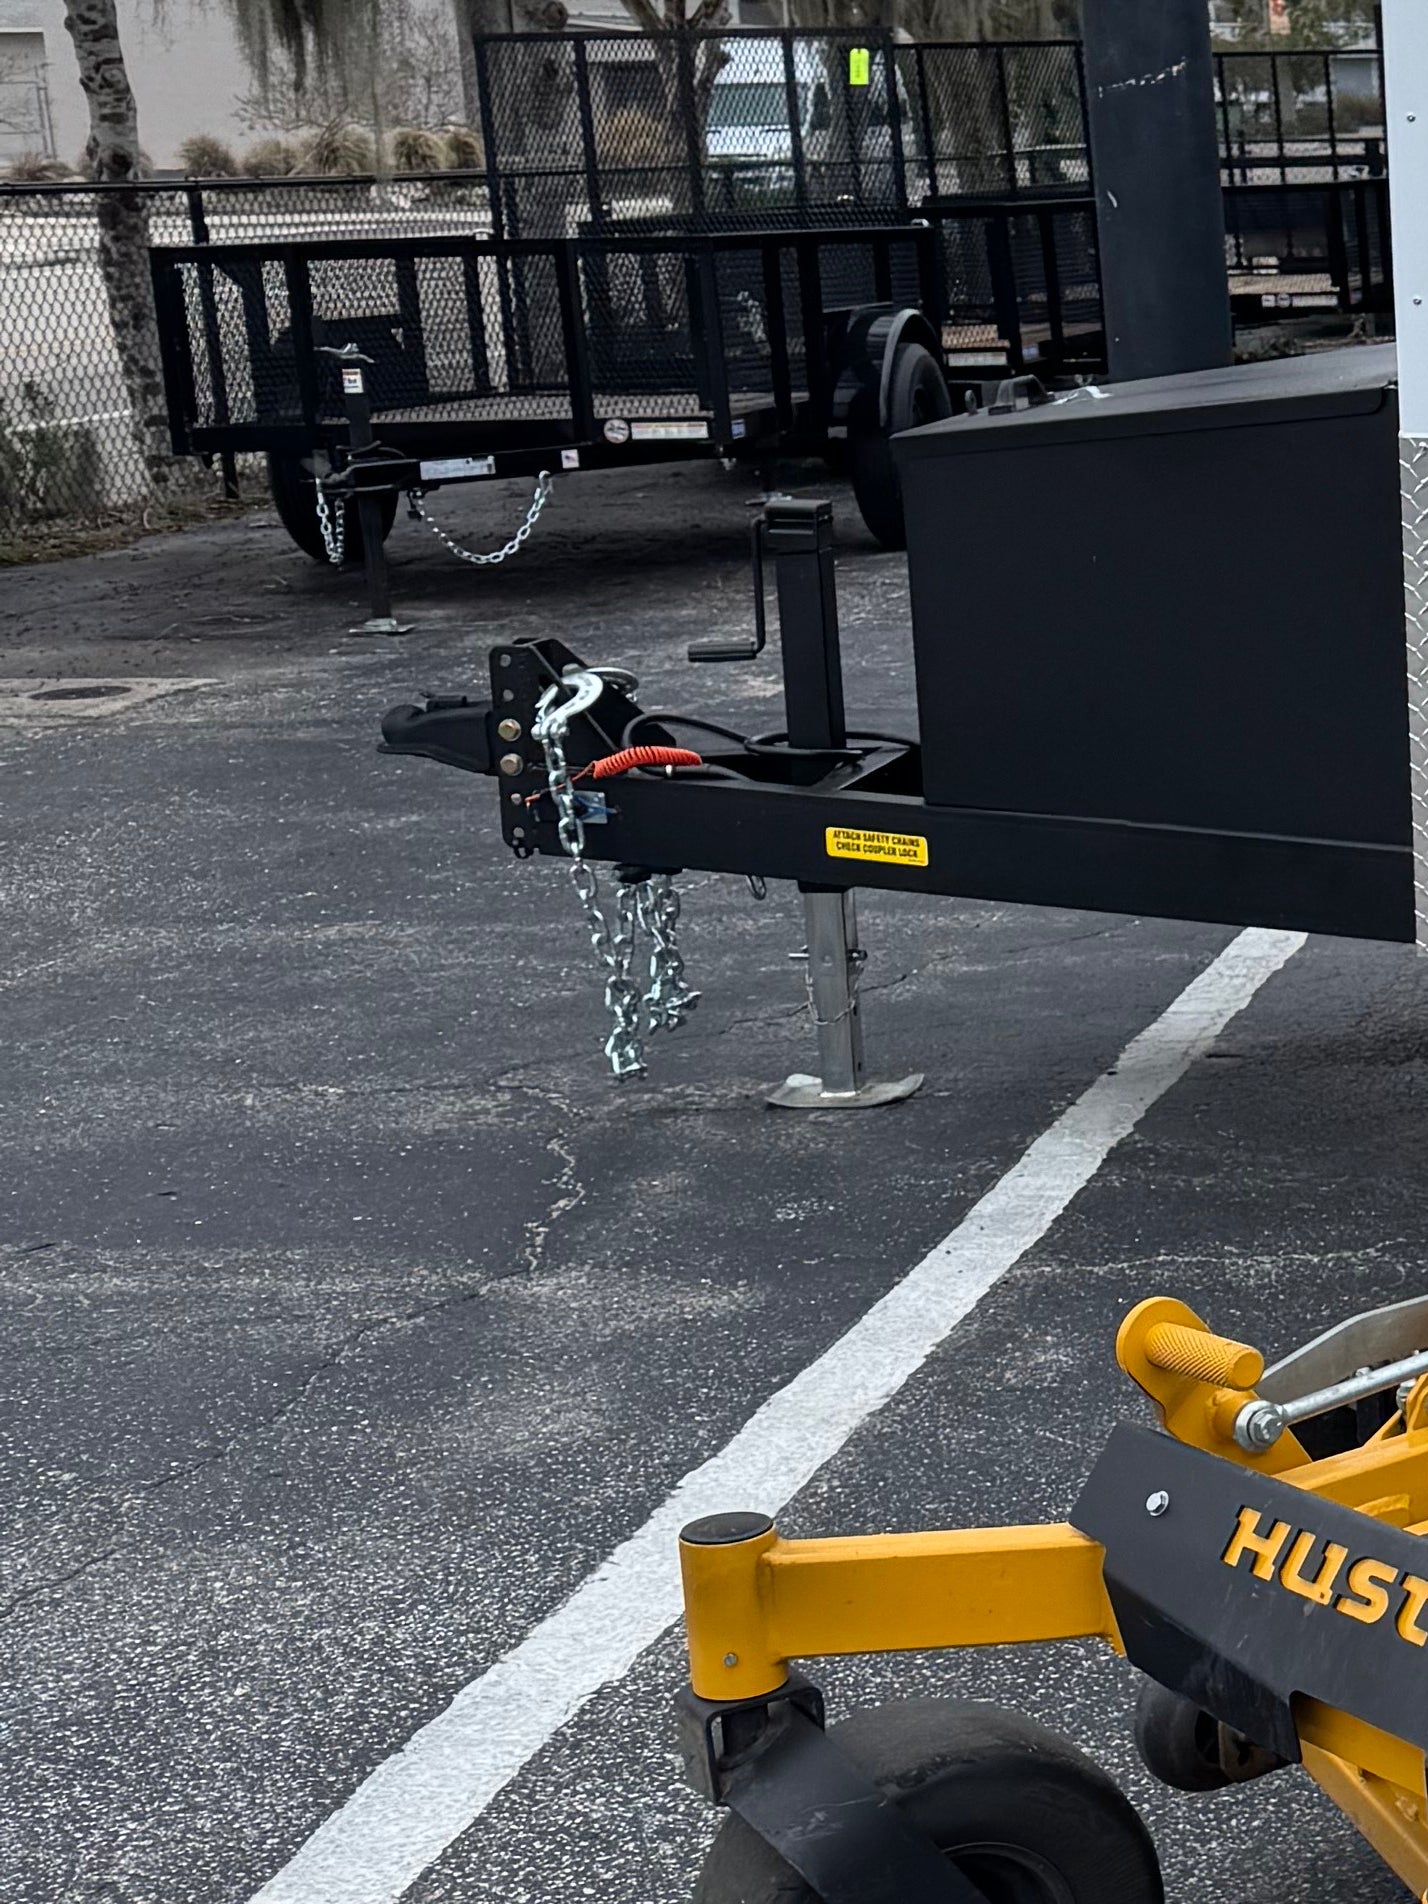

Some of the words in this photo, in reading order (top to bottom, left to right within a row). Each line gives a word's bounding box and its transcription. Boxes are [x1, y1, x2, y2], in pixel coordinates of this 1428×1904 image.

[832, 829, 861, 841] ATTACH
[863, 832, 890, 844] SAFETY
[891, 836, 920, 848] CHAINS
[836, 841, 861, 852] CHECK
[863, 843, 897, 856] COUPLER
[899, 847, 918, 859] LOCK
